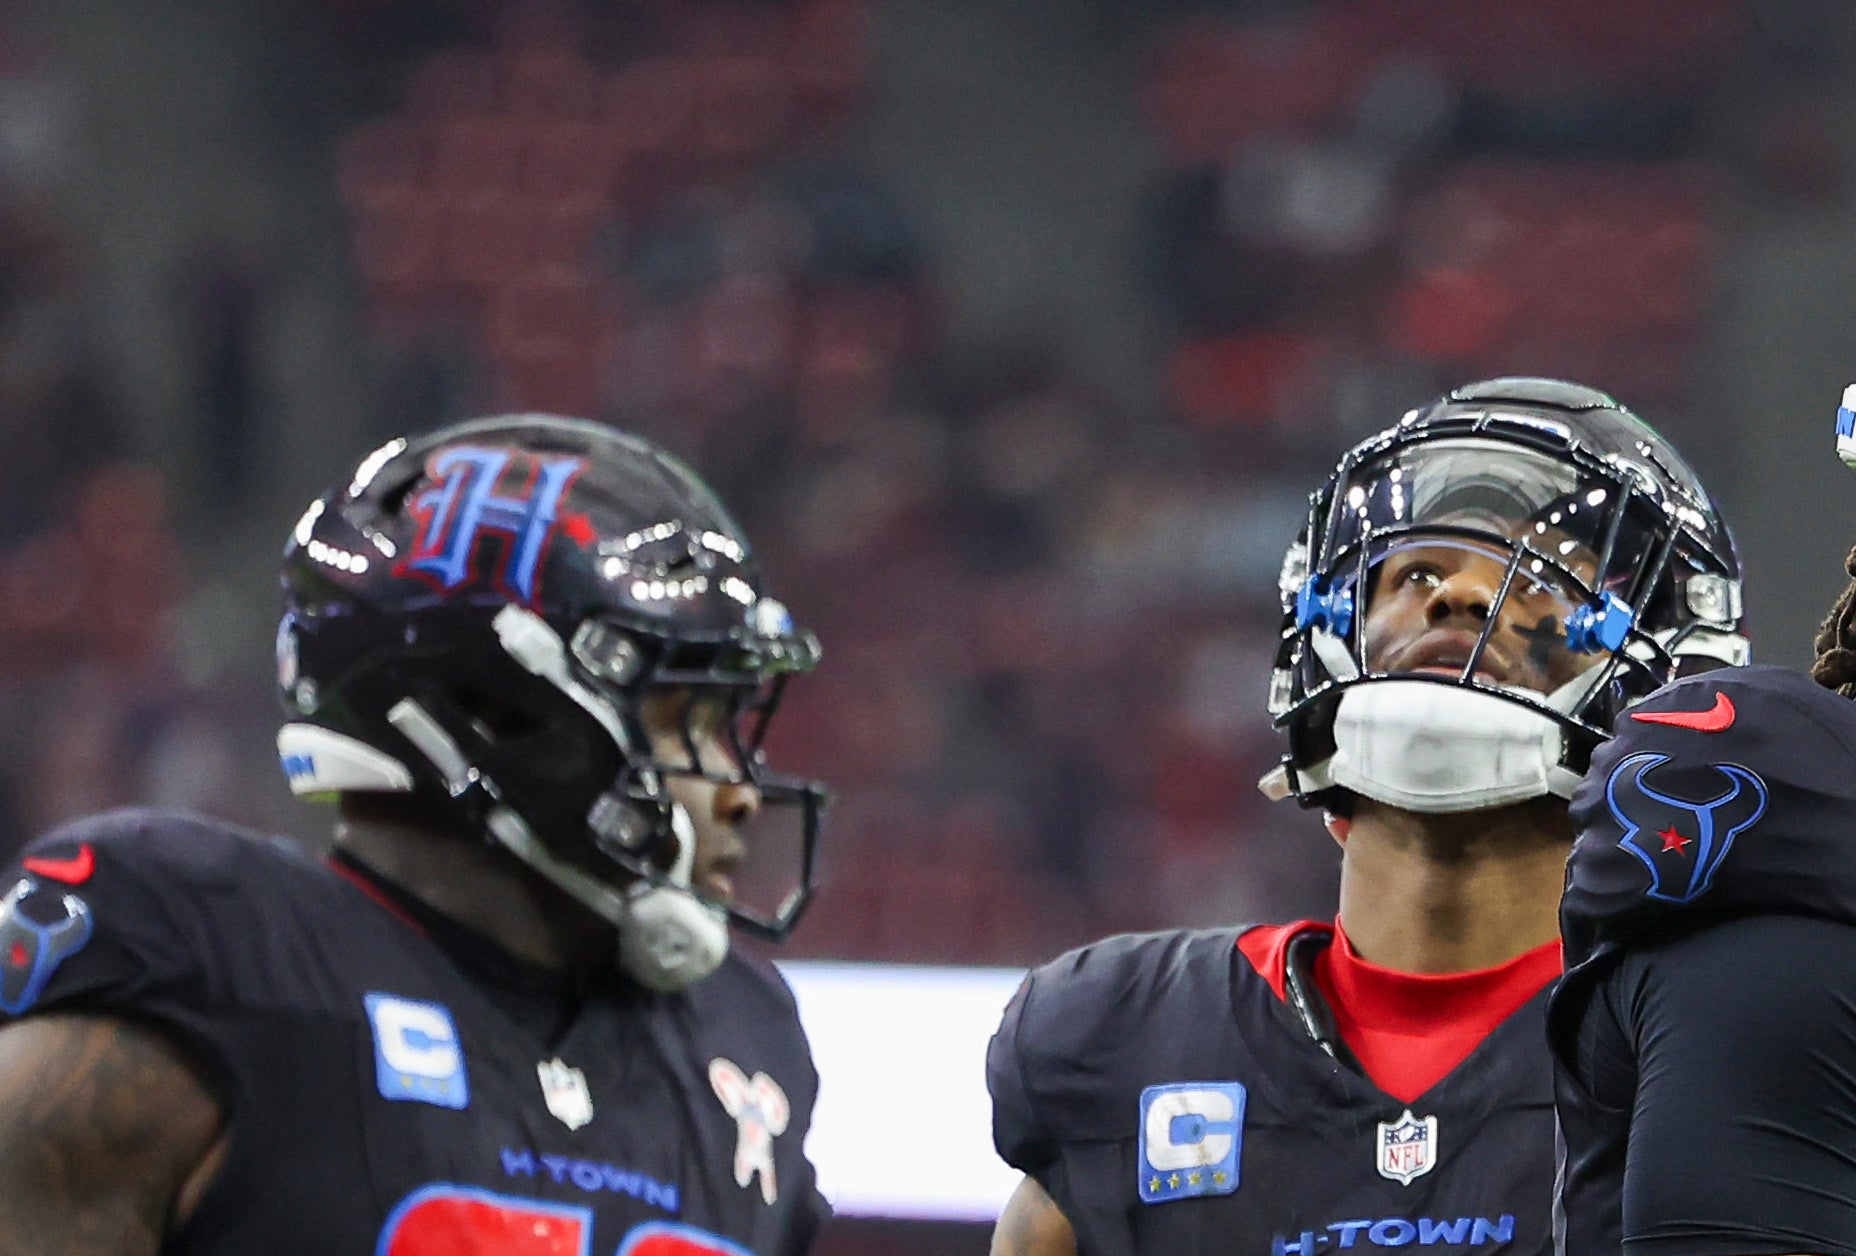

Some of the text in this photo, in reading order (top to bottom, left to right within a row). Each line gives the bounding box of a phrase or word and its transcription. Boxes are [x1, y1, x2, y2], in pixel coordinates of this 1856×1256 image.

[373, 1002, 457, 1078] C
[1146, 1090, 1237, 1171] C
[1388, 1143, 1425, 1171] NFL
